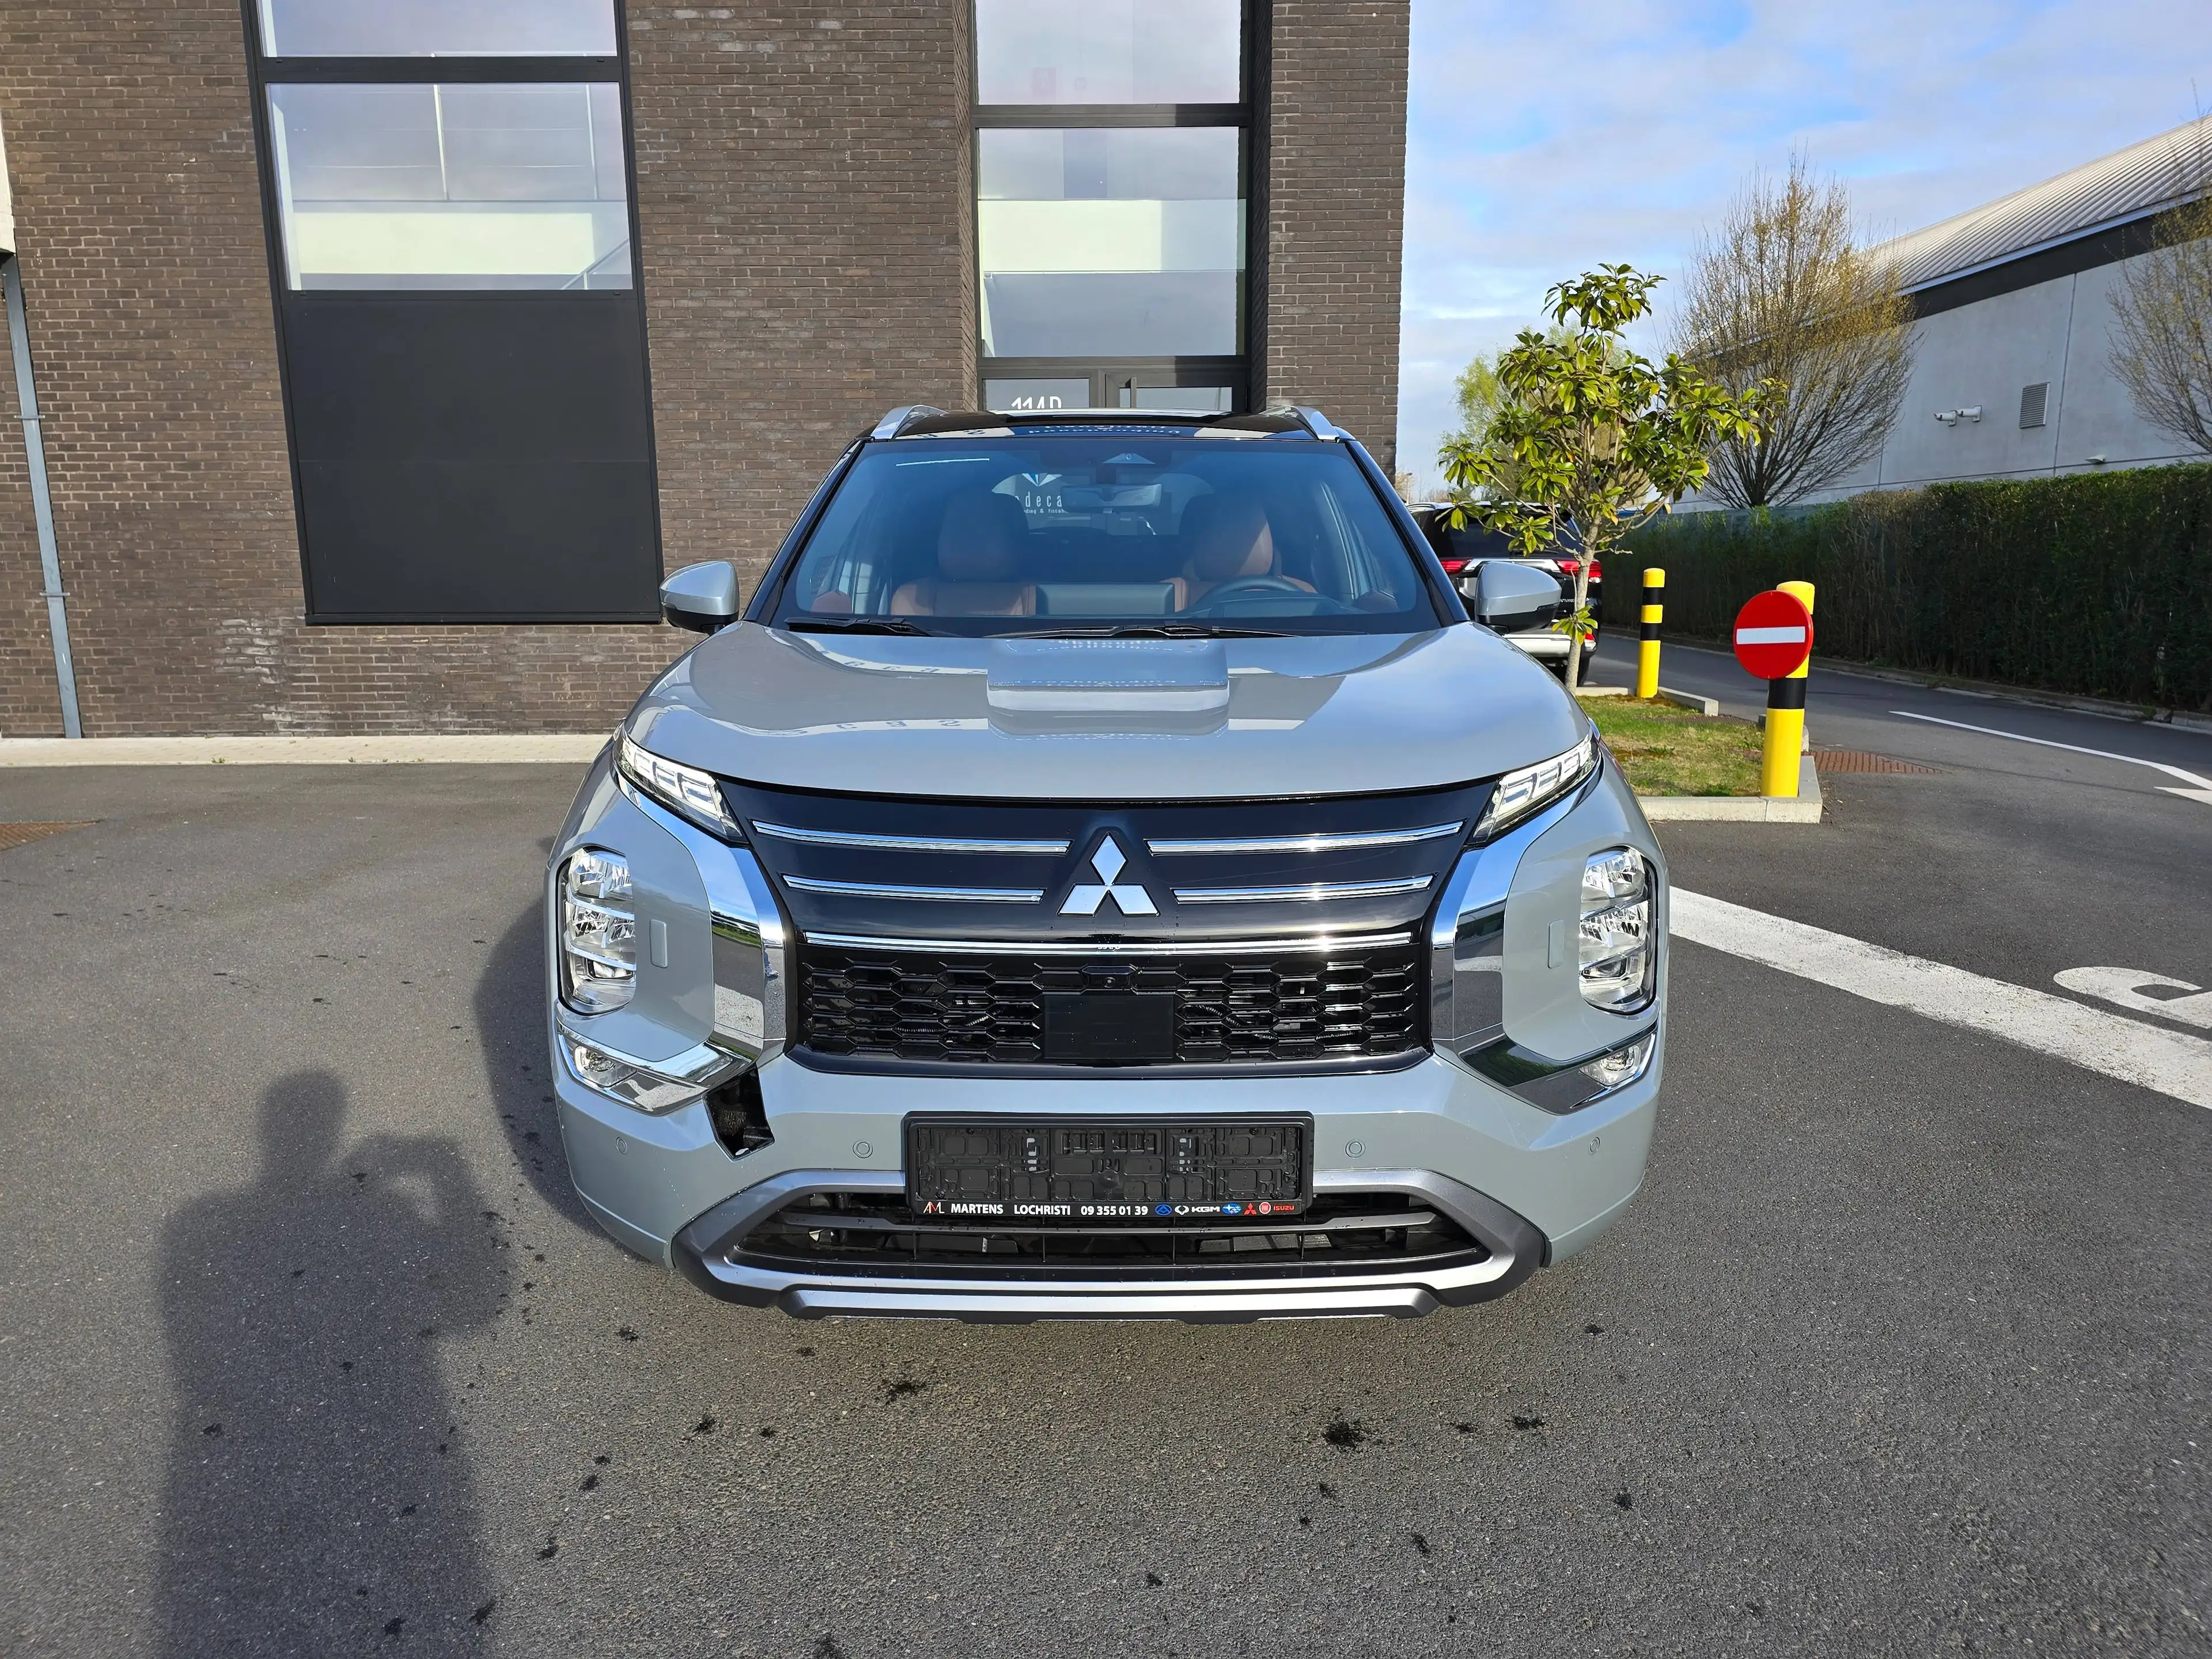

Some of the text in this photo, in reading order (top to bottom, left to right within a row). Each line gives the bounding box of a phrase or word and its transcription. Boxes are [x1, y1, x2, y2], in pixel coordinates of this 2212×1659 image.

[951, 1203, 1003, 1214] MARTENS
[1014, 1205, 1071, 1215] LOCHRISTI
[1081, 1205, 1094, 1215] 09
[1096, 1206, 1116, 1215] 355
[1118, 1206, 1131, 1215] 01
[1134, 1205, 1149, 1215] 39
